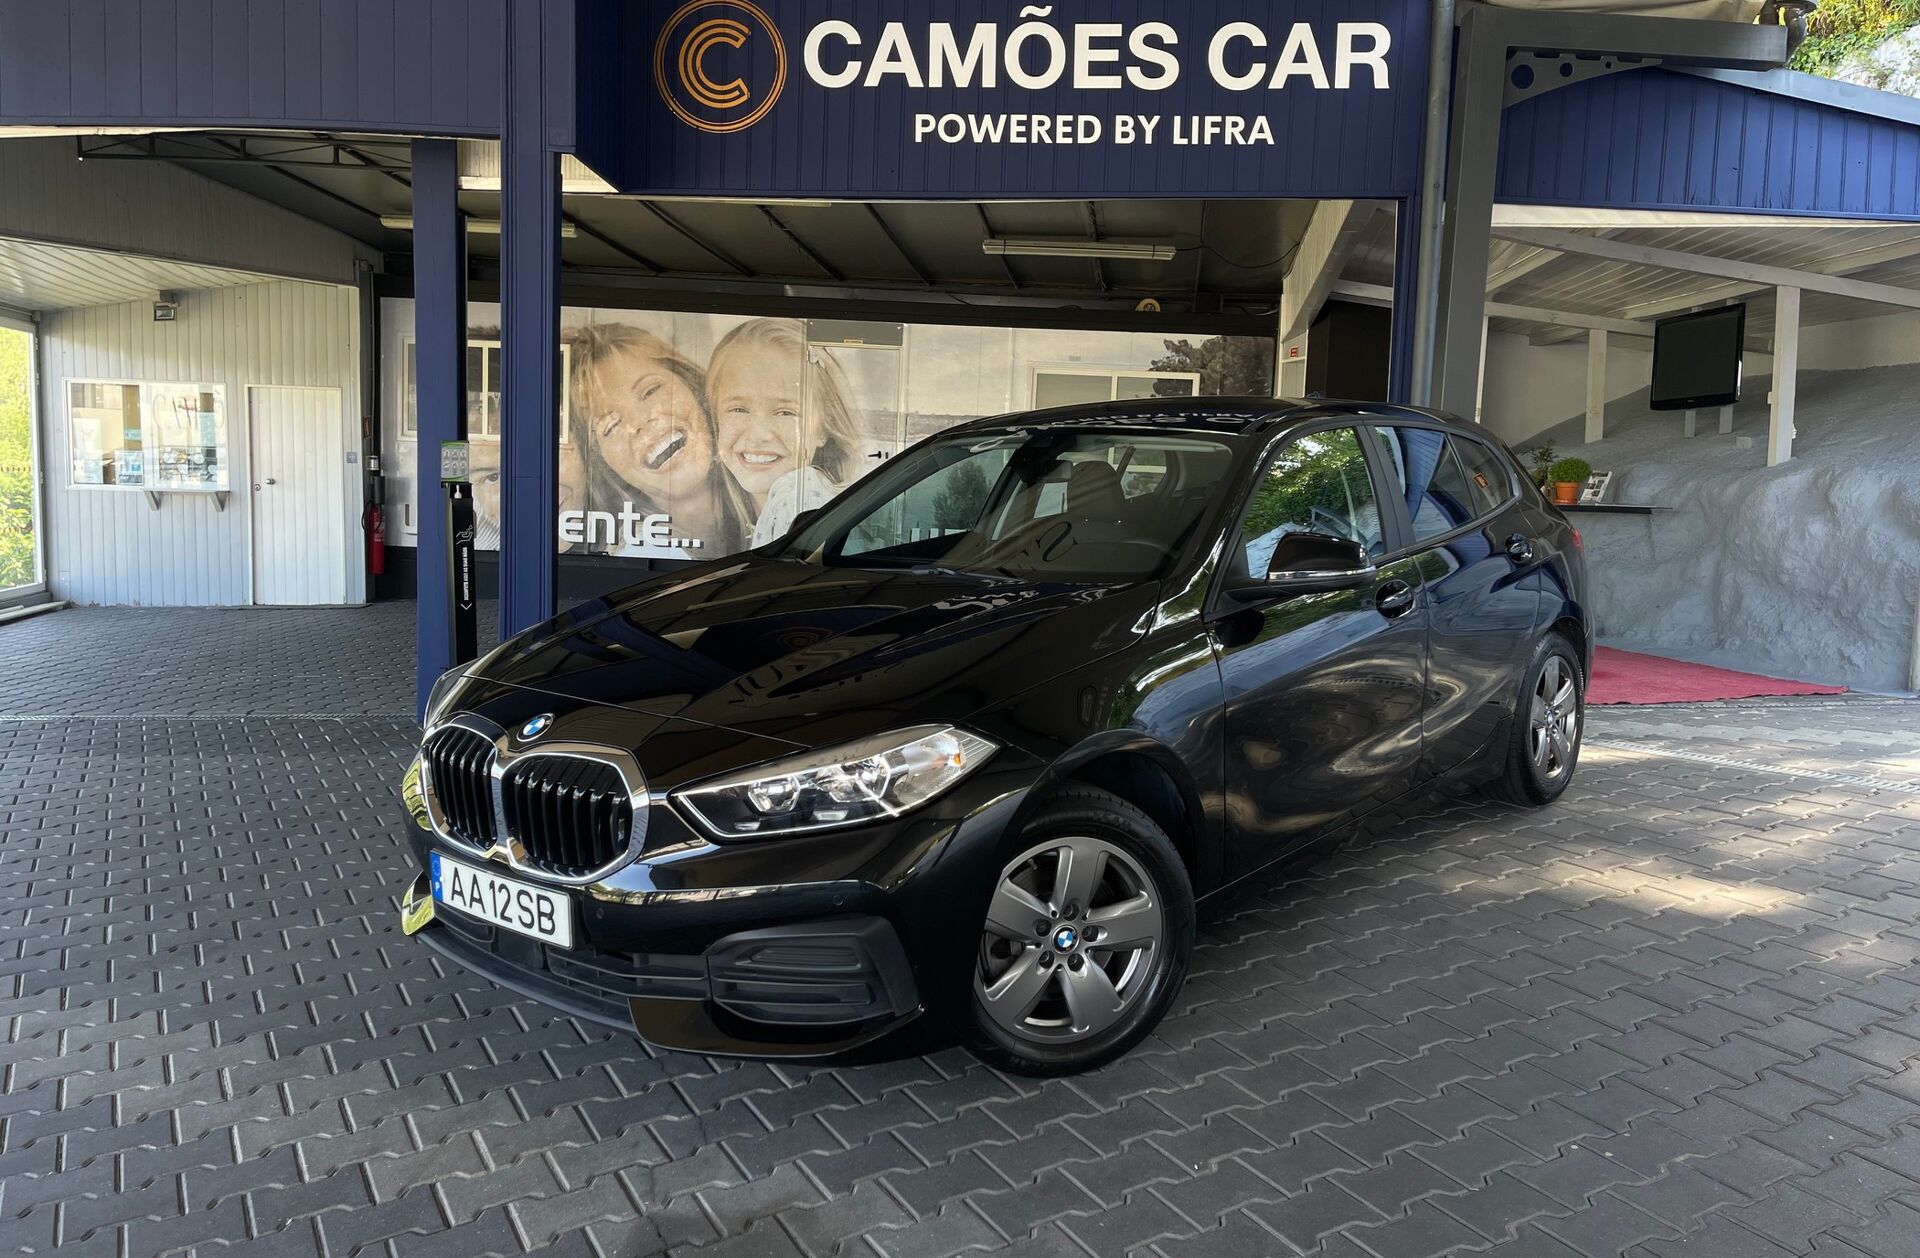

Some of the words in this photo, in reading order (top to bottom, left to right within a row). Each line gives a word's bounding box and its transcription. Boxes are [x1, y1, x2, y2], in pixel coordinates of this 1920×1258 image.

[803, 5, 1180, 91] CAMÕES
[1207, 21, 1392, 91] CAR
[915, 113, 1102, 144] POWERED
[1114, 114, 1161, 145] BY
[1173, 115, 1275, 145] LIFRA
[450, 866, 556, 936] AA12SB
